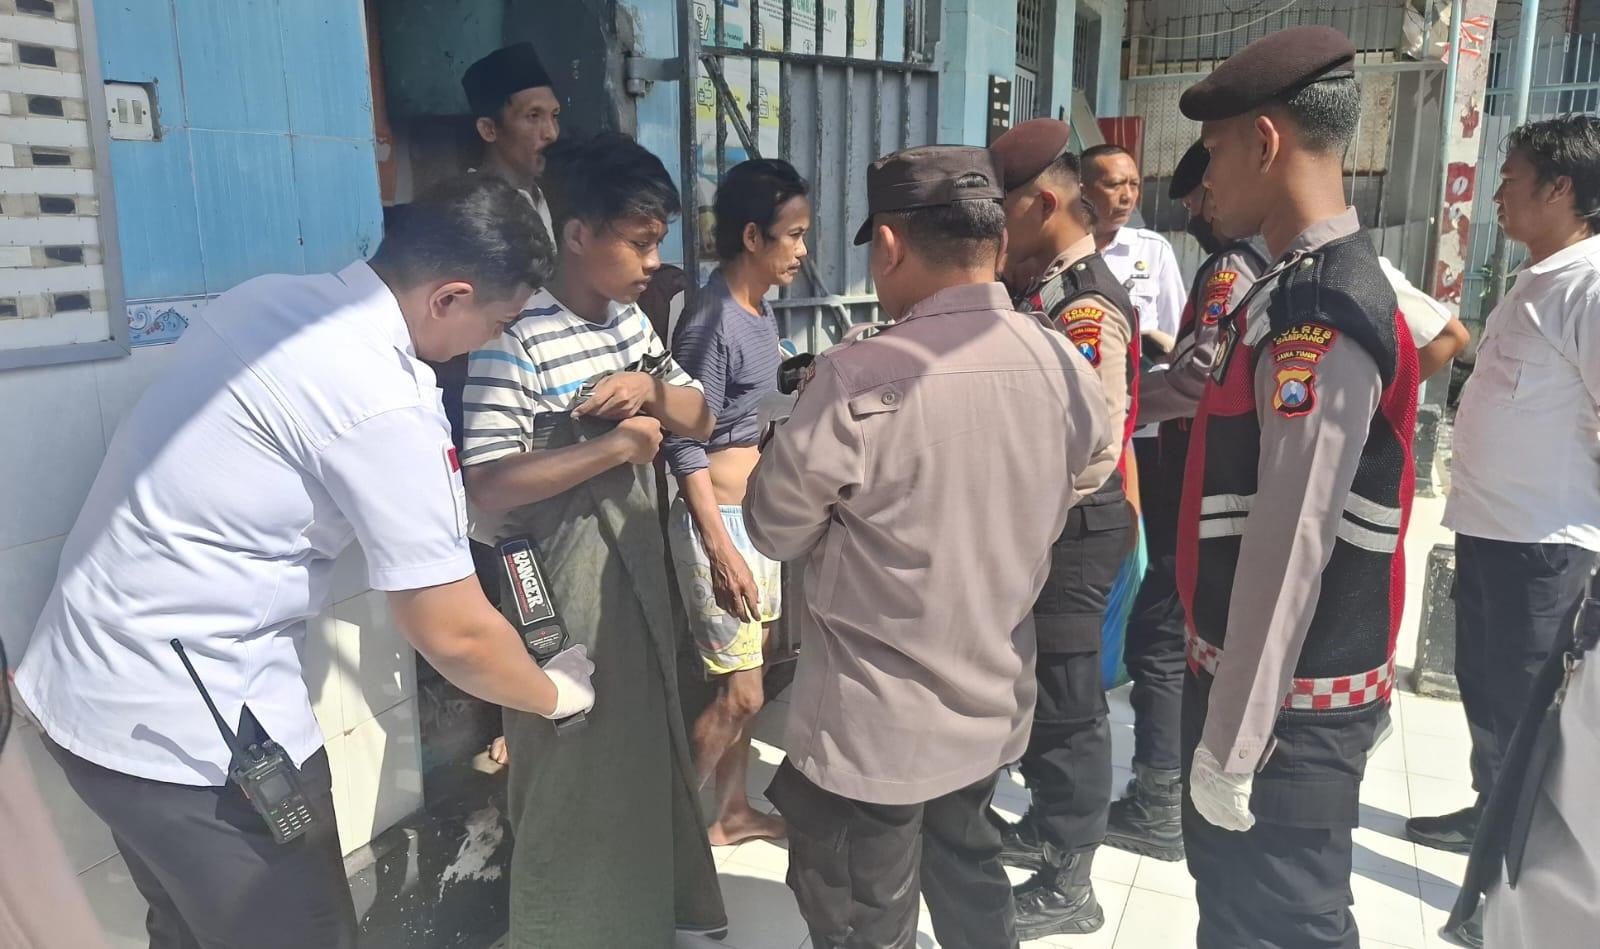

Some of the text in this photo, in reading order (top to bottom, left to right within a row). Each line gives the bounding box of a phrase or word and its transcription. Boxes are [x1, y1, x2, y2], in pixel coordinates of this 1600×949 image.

[1274, 333, 1325, 345] SAMPANG
[1277, 325, 1332, 340] OLRES
[1276, 350, 1318, 361] JAWA TIMUR
[512, 550, 543, 608] RANGER
